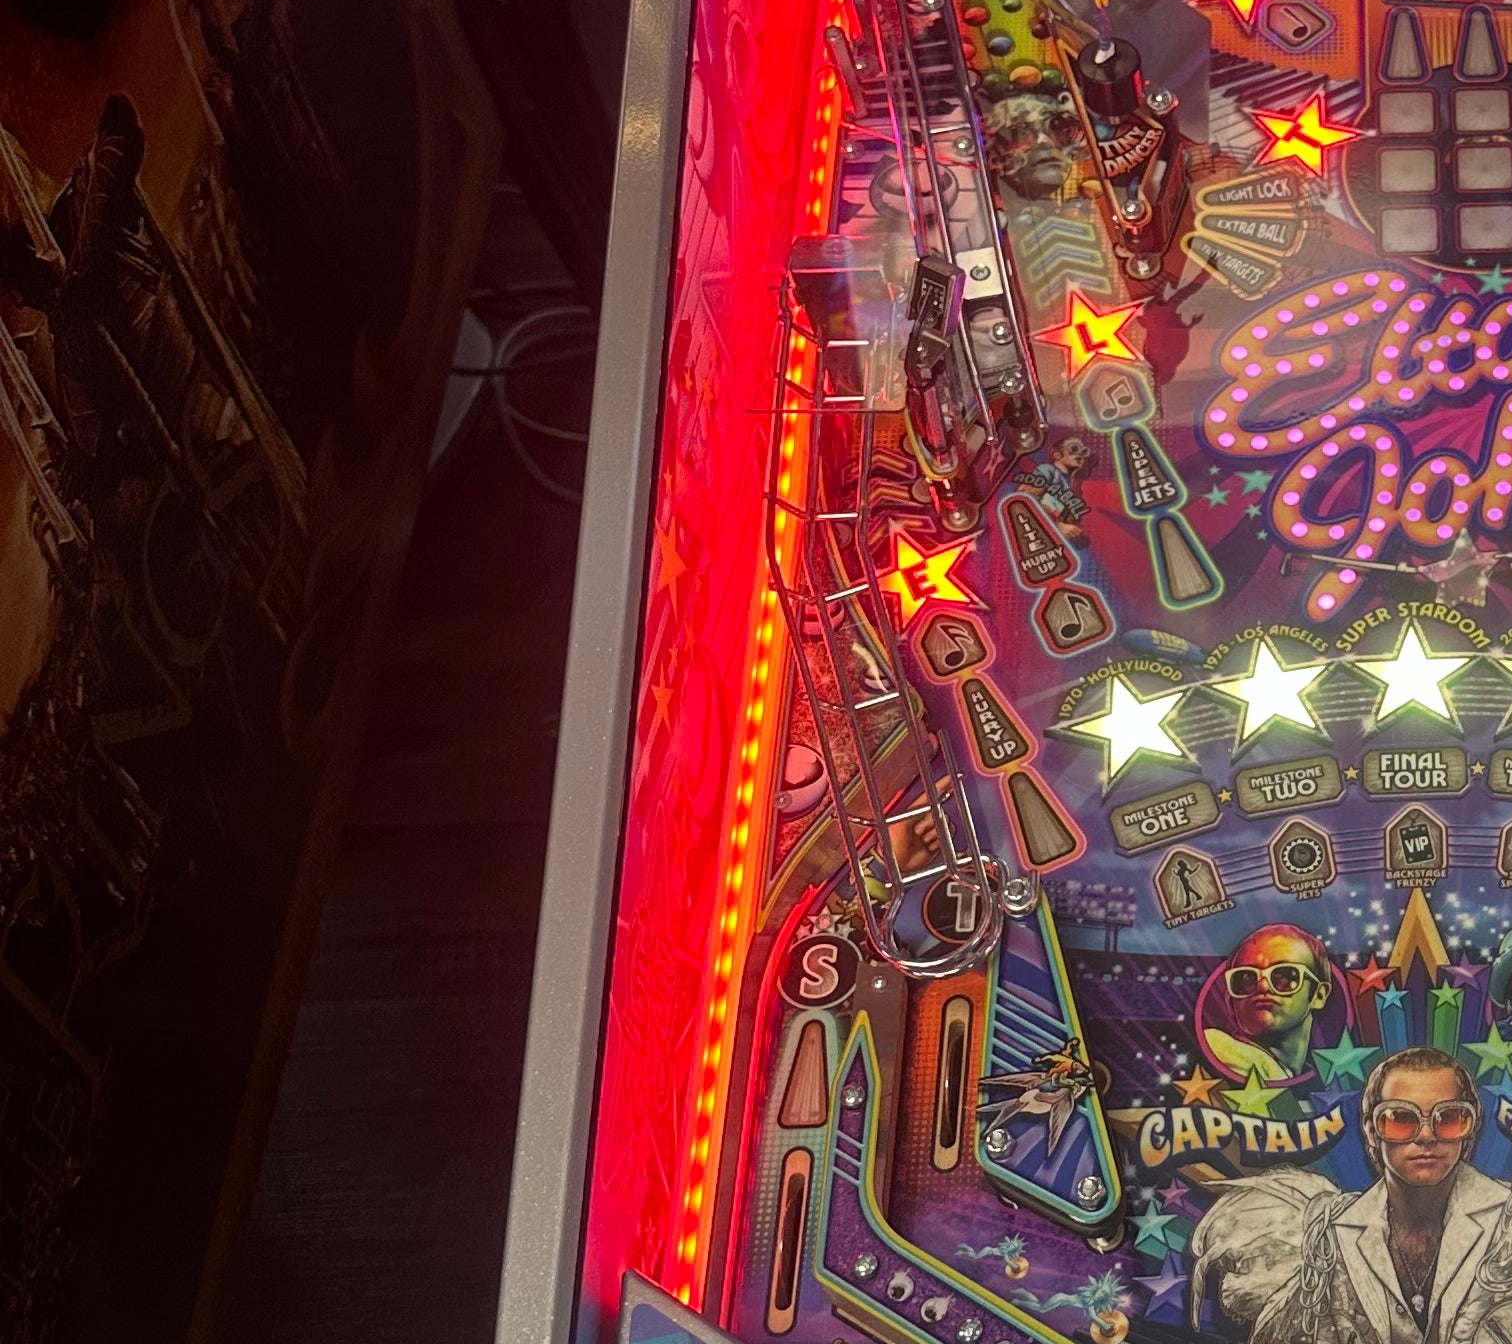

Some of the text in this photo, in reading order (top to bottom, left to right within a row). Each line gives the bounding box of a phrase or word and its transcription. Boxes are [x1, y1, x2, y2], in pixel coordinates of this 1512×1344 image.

[1099, 126, 1144, 157] TINY
[1104, 129, 1163, 178] DANCER
[1219, 177, 1292, 202] LIGHT LOCK
[1217, 219, 1288, 244] EXTRA BALL
[1222, 251, 1265, 285] TARGETS
[1129, 440, 1159, 488] SUPER
[1013, 472, 1091, 519] ADD-A-BALL
[1133, 481, 1177, 506] JETS
[1021, 547, 1064, 572] HURRY
[1037, 560, 1057, 575] UP
[1335, 601, 1492, 652] SUPER STARDOM
[1203, 623, 1329, 670] 1975 LOS ANGELES
[1059, 660, 1184, 718] 1970 HOLLYWOOD
[990, 739, 1017, 760] UP
[1380, 752, 1448, 772] FINAL
[1251, 766, 1323, 789] MILESTONE
[1380, 768, 1448, 791] TOUR
[1261, 778, 1317, 803] TWO
[1123, 793, 1197, 826] MILESTONE
[1139, 807, 1189, 837] ONE
[1405, 834, 1430, 854] VIP
[1290, 879, 1326, 894] SUPER
[1385, 868, 1448, 880] BACKSTAGE
[1396, 877, 1438, 888] FRENZY
[946, 882, 979, 933] T
[1297, 889, 1323, 901] JETS
[1164, 899, 1236, 928] TINY TARGETS
[801, 944, 839, 1000] S
[1138, 1102, 1347, 1168] CAPTAIN
